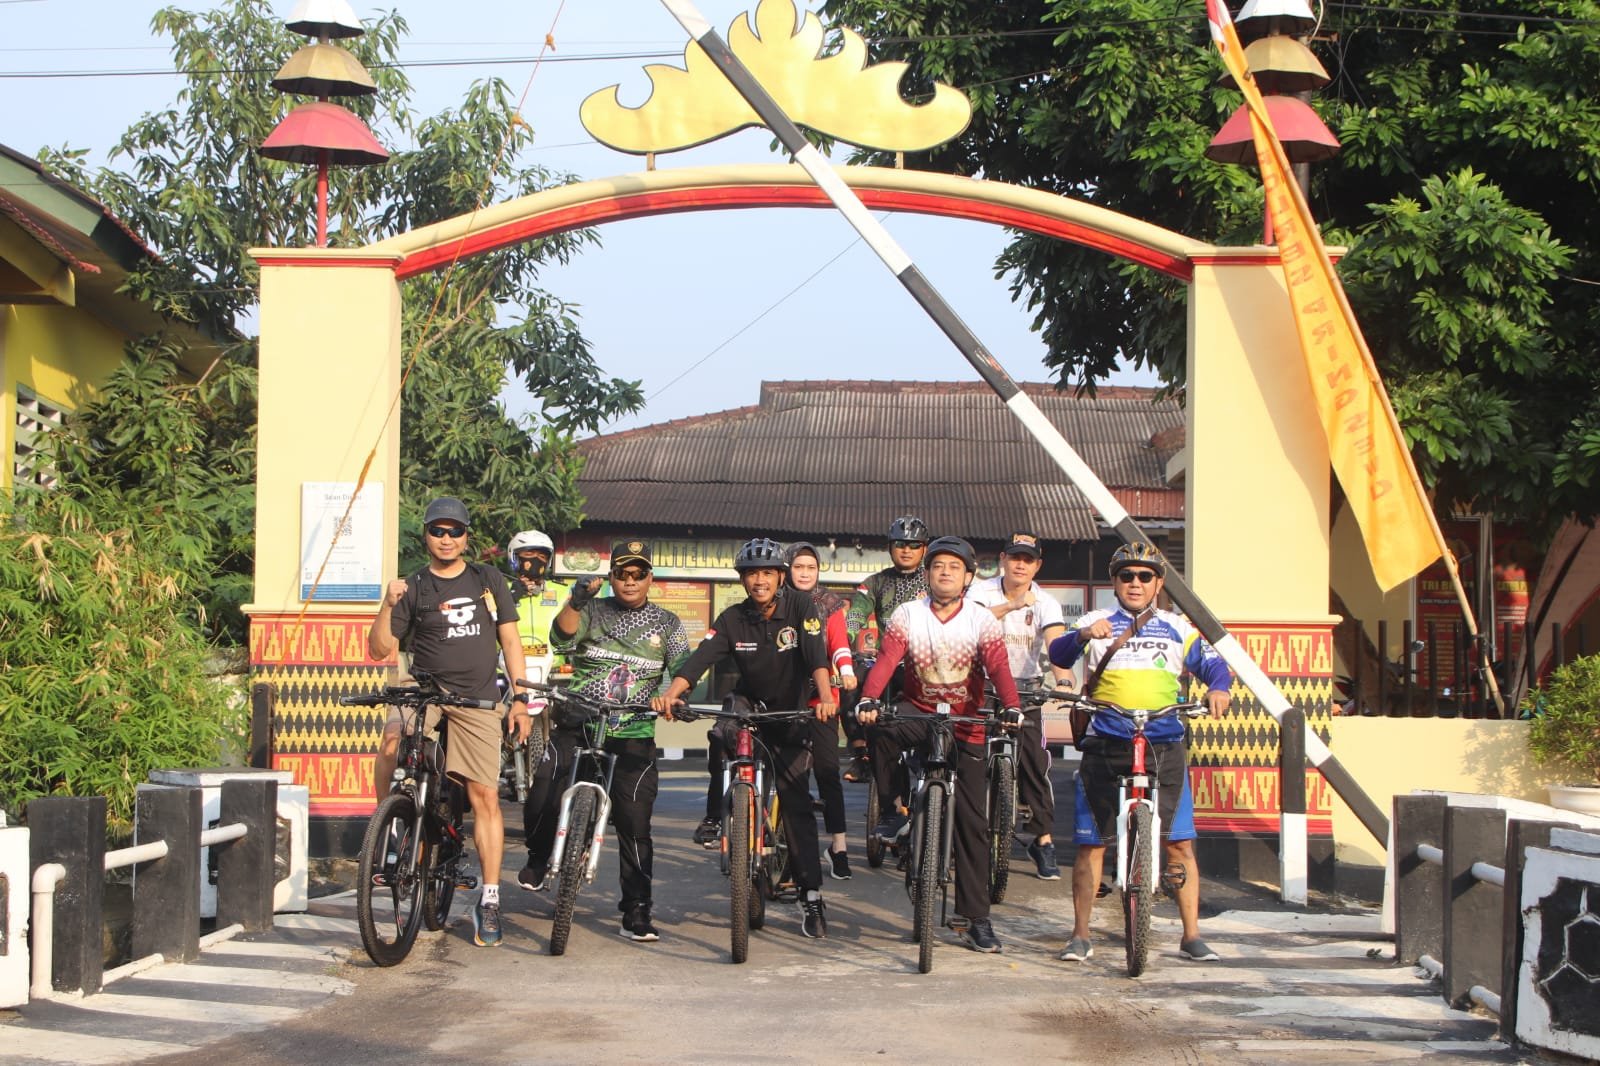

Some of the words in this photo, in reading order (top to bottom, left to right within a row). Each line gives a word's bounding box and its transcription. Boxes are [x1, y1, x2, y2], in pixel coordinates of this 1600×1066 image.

[653, 540, 736, 568] INTELKA
[447, 623, 481, 639] ASU!
[1107, 640, 1168, 653] ayco
